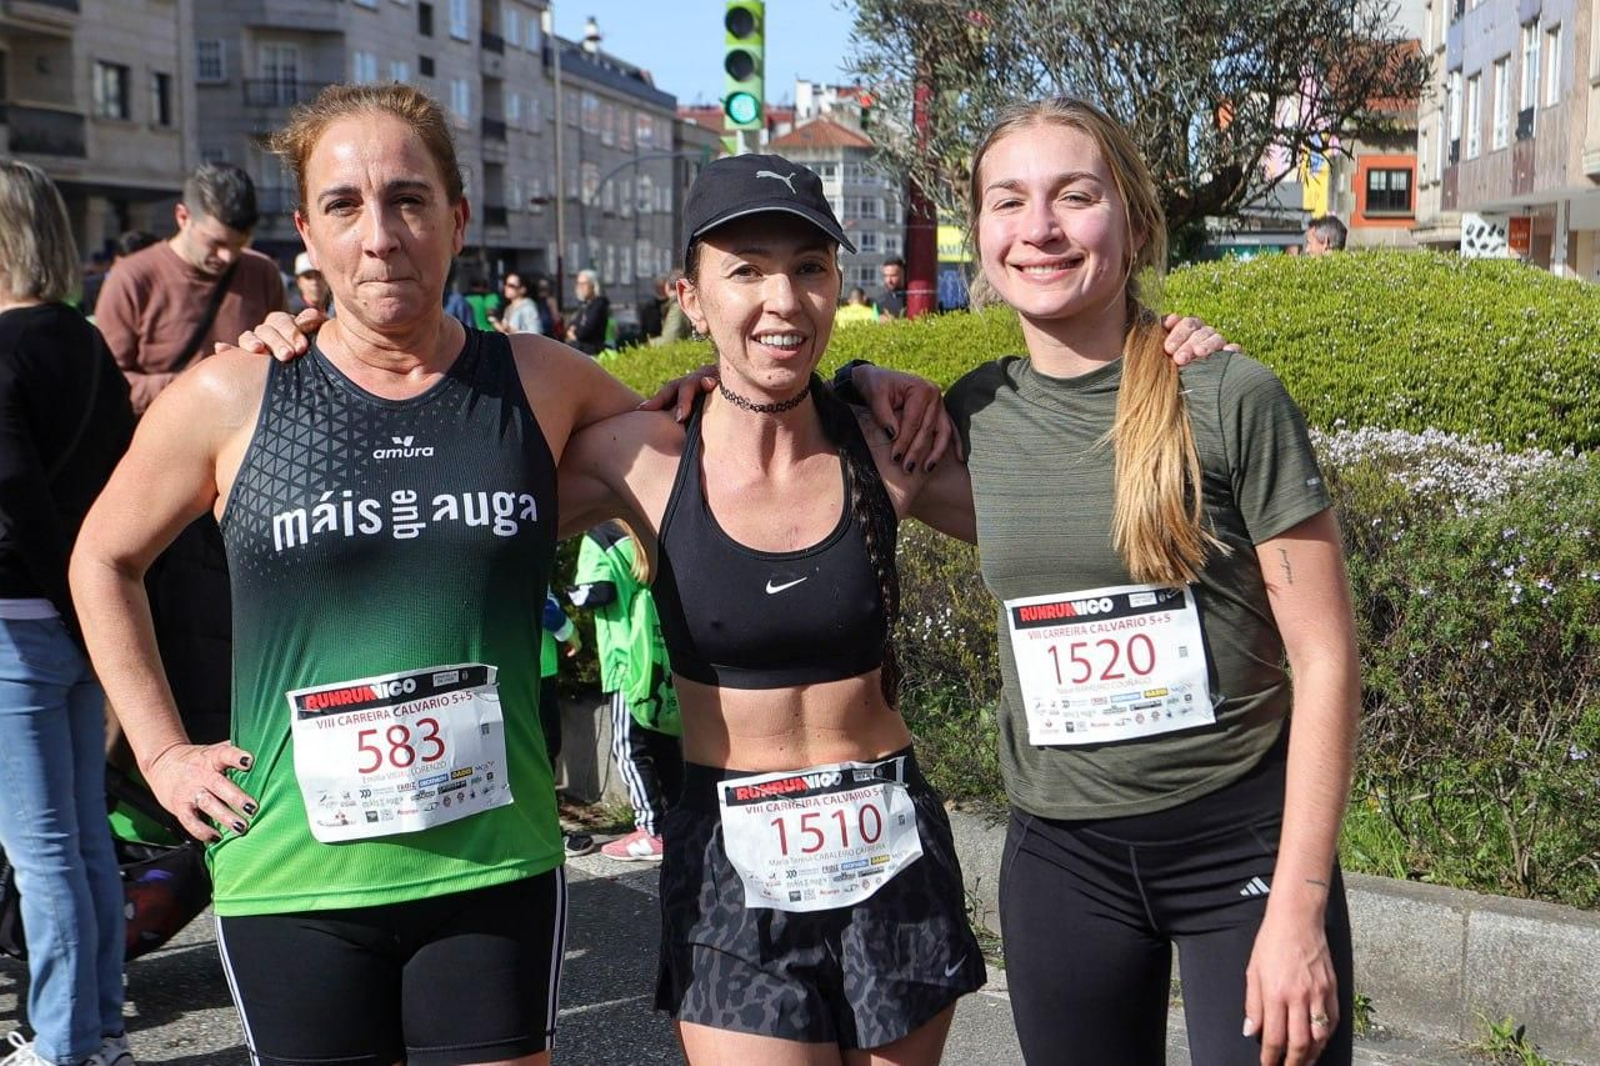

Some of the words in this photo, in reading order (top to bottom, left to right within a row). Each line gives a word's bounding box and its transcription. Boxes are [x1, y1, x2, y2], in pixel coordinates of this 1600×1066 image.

[372, 446, 435, 460] amura
[273, 490, 383, 552] máis
[391, 489, 427, 540] que
[432, 491, 538, 537] auga
[1028, 630, 1042, 640] VIII
[1044, 626, 1087, 639] CARREIRA
[1089, 617, 1147, 634] CALVARIO
[1150, 613, 1171, 626] 5+5
[1048, 633, 1156, 685] 1520
[316, 718, 335, 730] VIII
[337, 709, 391, 727] CARREIRA
[393, 698, 450, 718] CALVARIO
[452, 690, 473, 705] 5+5
[358, 718, 446, 775] 583
[745, 805, 763, 815] VIII
[823, 790, 872, 807] CALVARIO
[771, 803, 882, 857] 1510
